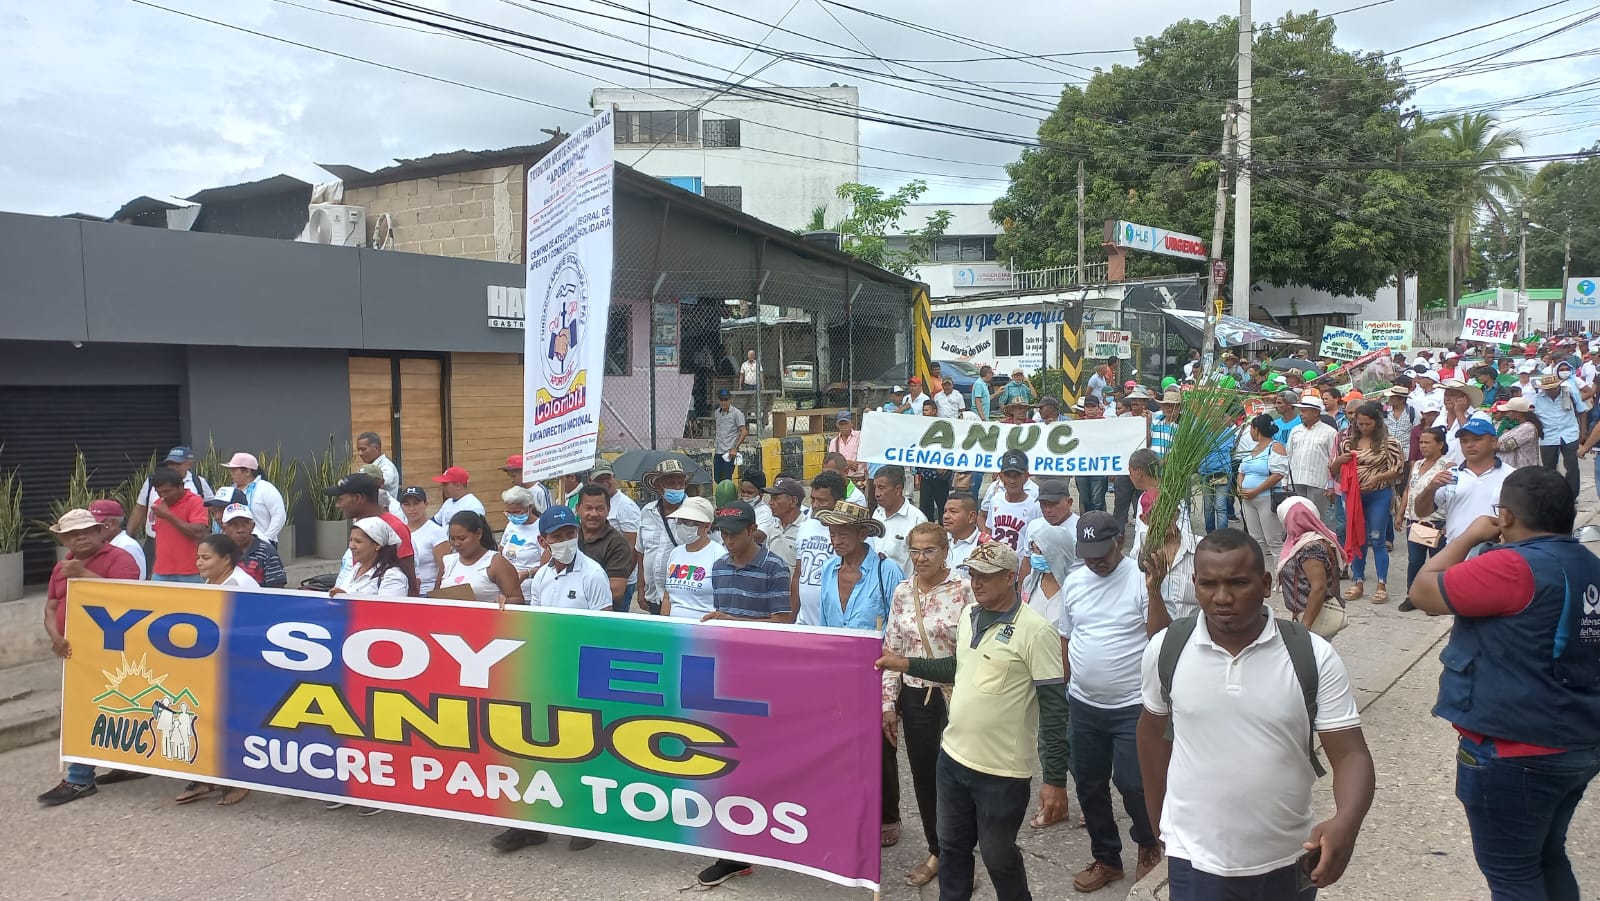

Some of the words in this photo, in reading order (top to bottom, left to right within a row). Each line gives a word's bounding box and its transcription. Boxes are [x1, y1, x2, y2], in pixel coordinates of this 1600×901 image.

[601, 112, 611, 129] PAZ
[530, 243, 549, 260] CENTRO
[601, 205, 611, 217] DE
[530, 256, 548, 272] AFECTO
[487, 285, 525, 318] HA
[1573, 297, 1596, 306] HUS
[492, 319, 525, 328] GASTR
[931, 312, 961, 329] rales
[965, 313, 974, 332] y
[1465, 317, 1517, 333] ASOGRAN
[1472, 329, 1508, 339] PRESENTE
[940, 340, 950, 352] La
[950, 344, 968, 356] Gloria
[968, 346, 976, 356] de
[976, 339, 991, 354] Dios
[536, 384, 583, 420] Colombia
[528, 430, 543, 443] JUNTA
[542, 421, 567, 439] DIRECTIVA
[567, 413, 593, 431] NACIONAL
[919, 420, 1079, 454] ANUC
[884, 443, 969, 468] CIÉNAGA
[975, 453, 993, 469] DE
[1034, 456, 1123, 473] PRESENTE
[993, 514, 1026, 532] JORDAN
[1083, 526, 1096, 539] NY
[801, 539, 834, 555] EQUIPO
[82, 604, 221, 659] YO
[261, 621, 527, 689] SOY
[577, 645, 769, 717] EL
[91, 713, 148, 755] ANUC
[265, 681, 740, 781] ANUC
[242, 736, 397, 787] SUCRE
[411, 756, 564, 808] PARA
[580, 775, 809, 845] TODOS
